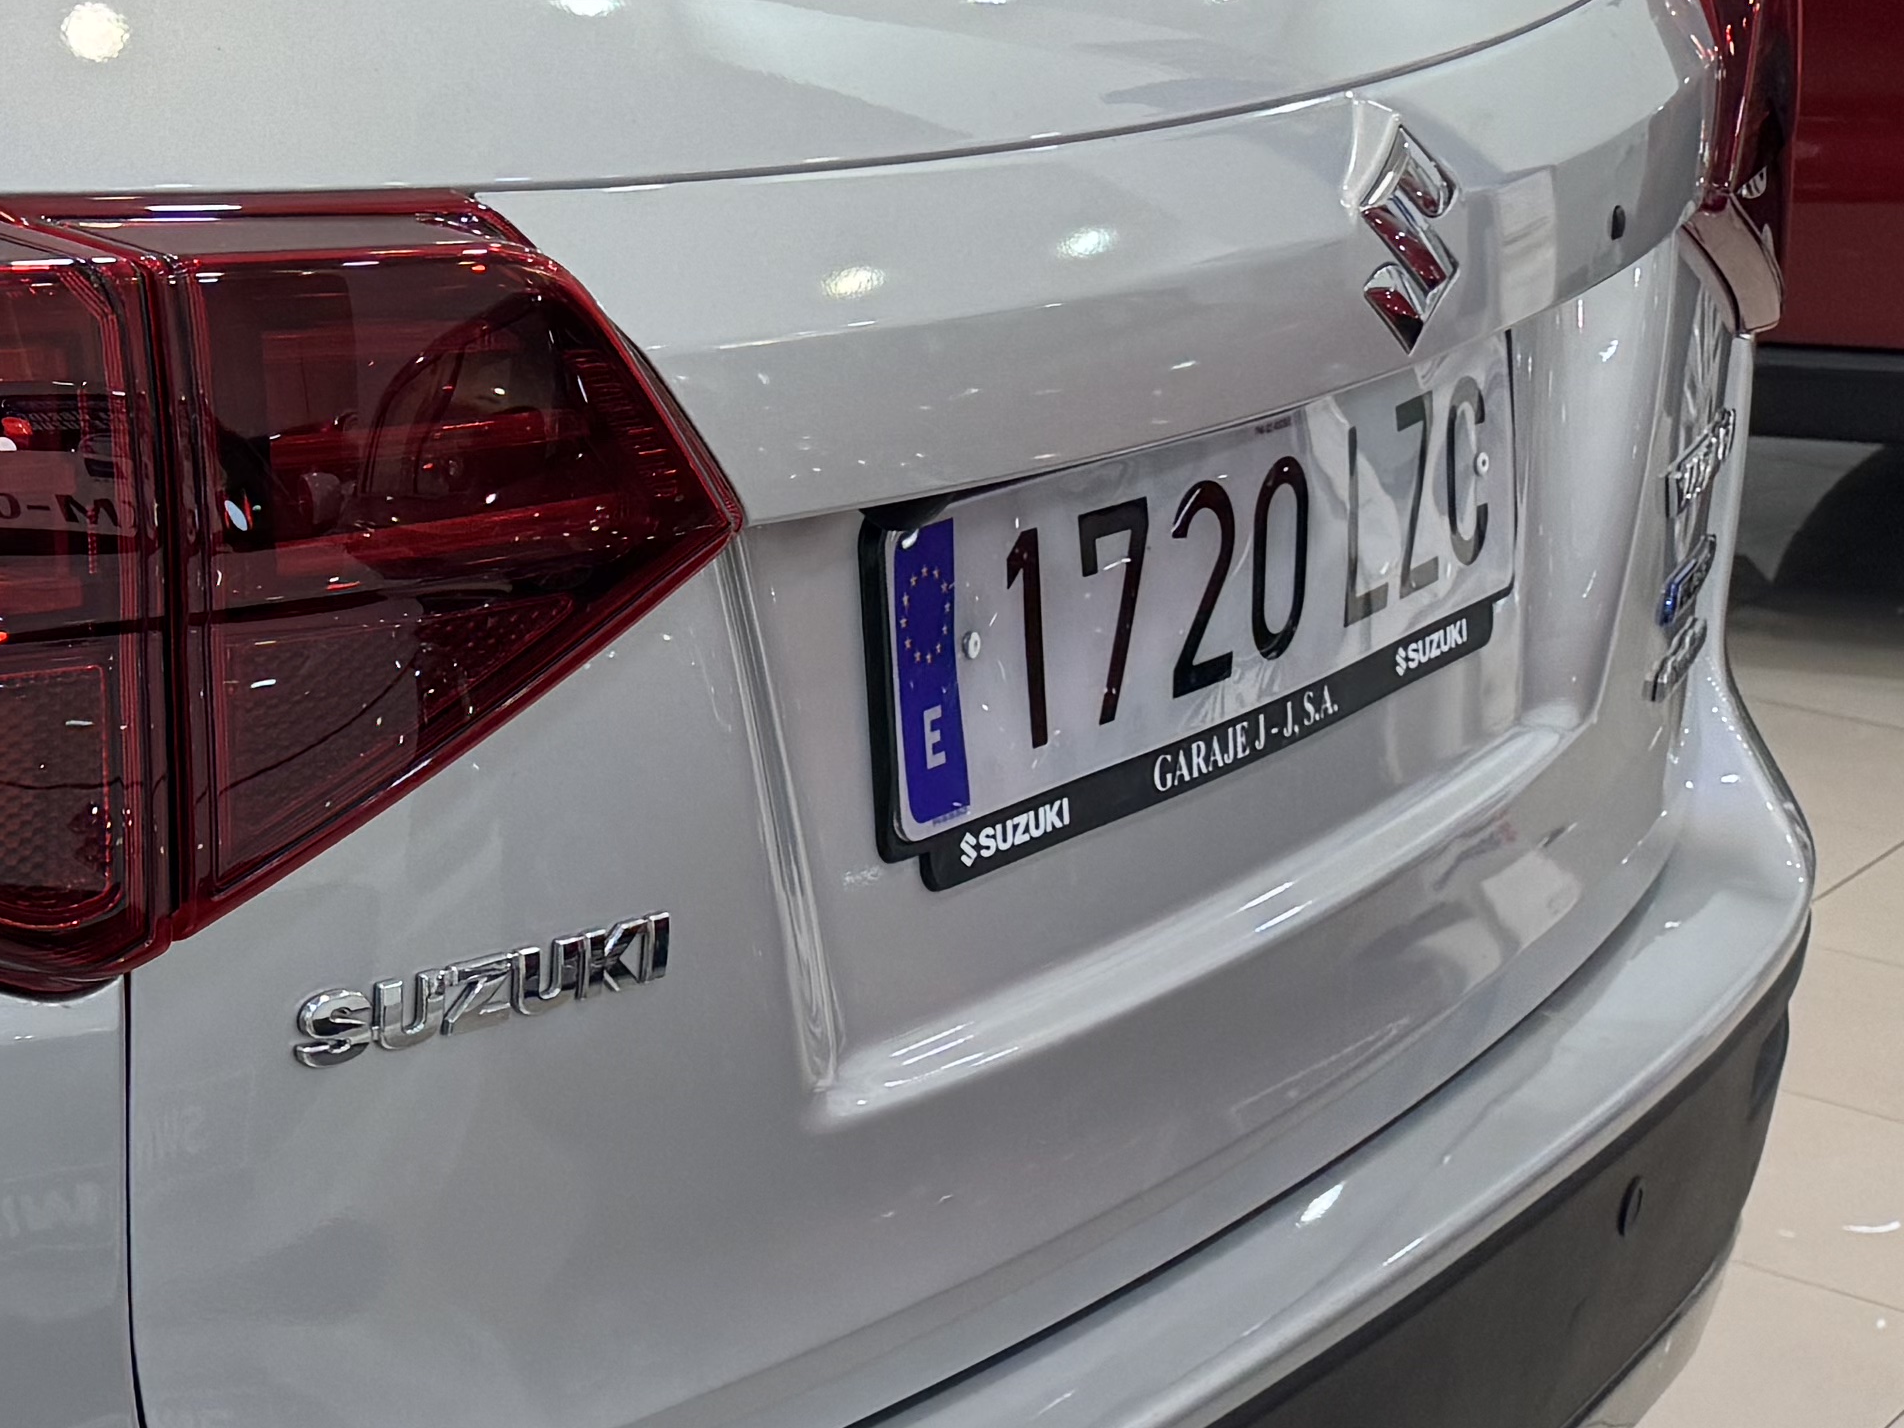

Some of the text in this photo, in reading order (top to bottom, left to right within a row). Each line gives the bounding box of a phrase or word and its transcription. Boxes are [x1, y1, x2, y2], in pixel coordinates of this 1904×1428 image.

[1006, 455, 1309, 749] 1720
[1343, 375, 1488, 628] LZC
[1406, 618, 1468, 670] SUZUKI
[923, 705, 946, 770] E
[1153, 721, 1250, 792] GARAJE
[1304, 684, 1339, 726] S.A.
[979, 796, 1070, 857] SUZUKI
[294, 910, 670, 1068] SUZUKI
